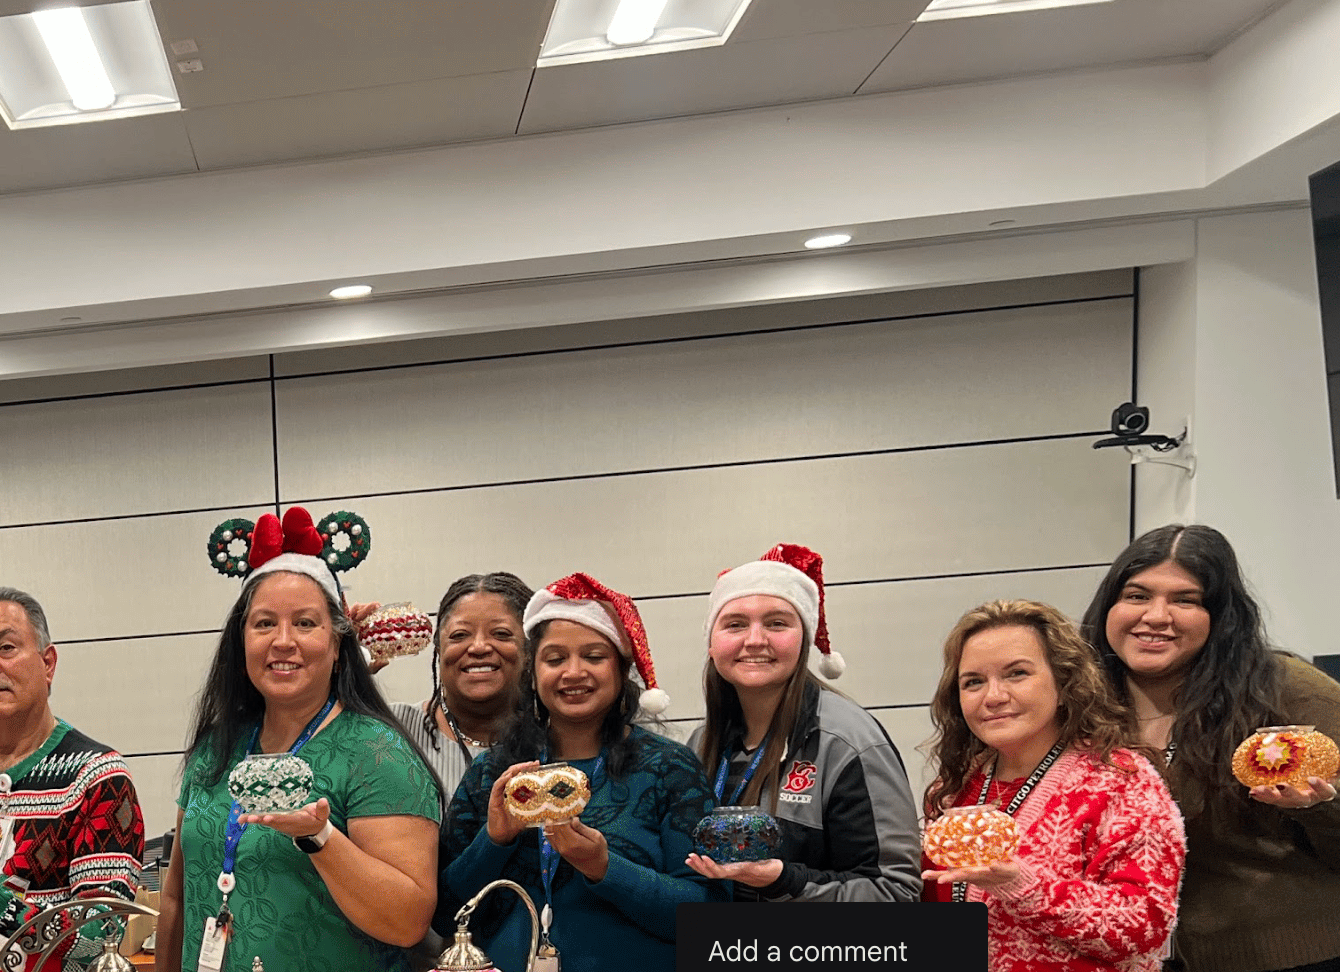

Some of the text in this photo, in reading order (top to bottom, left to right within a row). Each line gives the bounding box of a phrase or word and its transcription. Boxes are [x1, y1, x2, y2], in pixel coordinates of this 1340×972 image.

[779, 793, 813, 804] SOCCER
[1006, 740, 1066, 815] CITGO PETROLEU
